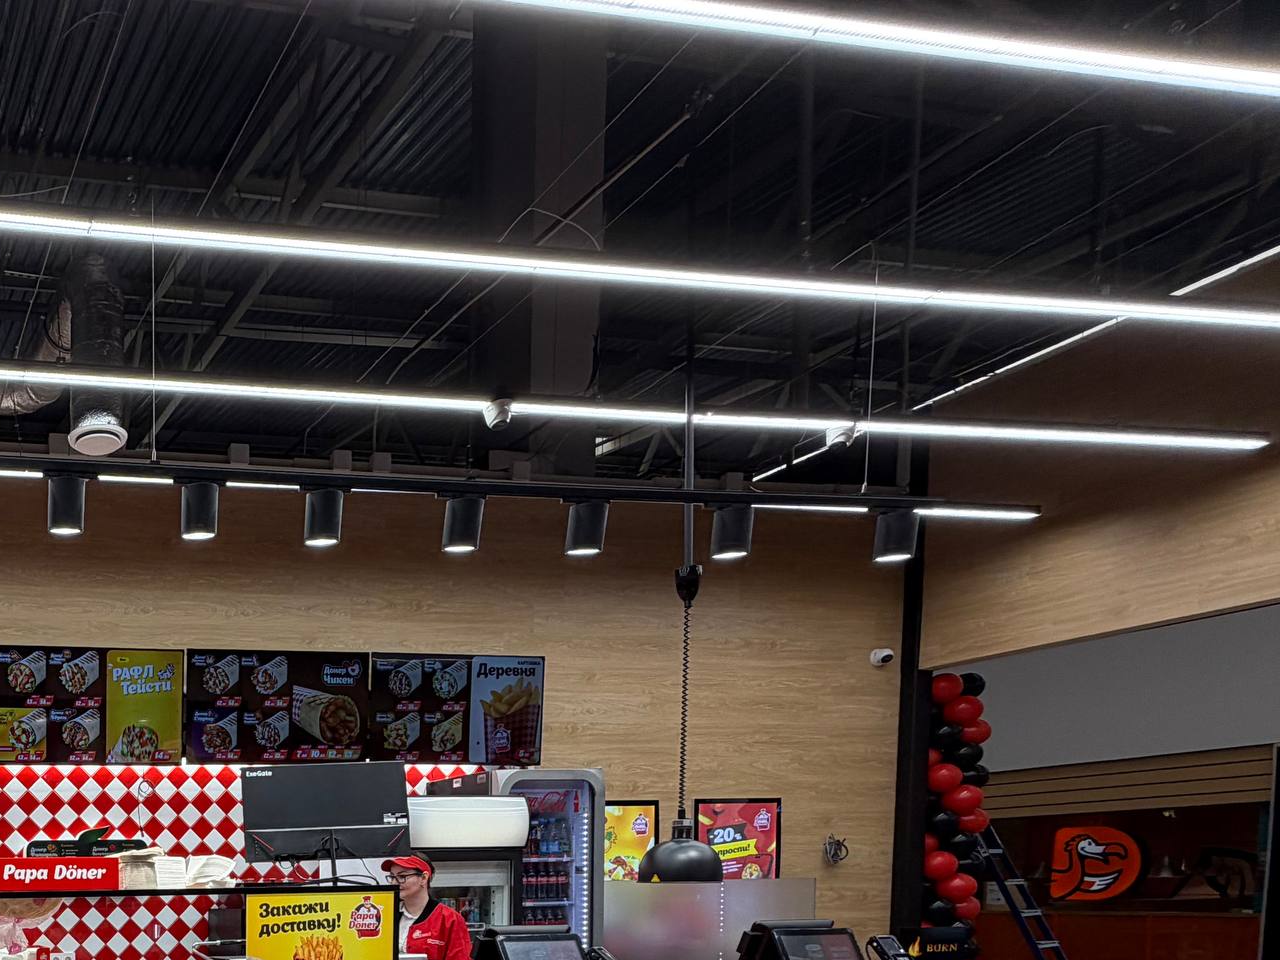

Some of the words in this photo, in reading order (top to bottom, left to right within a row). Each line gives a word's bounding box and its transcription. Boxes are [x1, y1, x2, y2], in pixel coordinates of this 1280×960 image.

[112, 664, 154, 682] РАФЛ
[323, 674, 354, 684] Чикен
[477, 663, 536, 679] Деревня
[121, 679, 173, 695] Тейсти
[3, 864, 48, 883] Papa
[54, 864, 106, 880] Döner
[259, 901, 329, 918] Закажи
[351, 911, 374, 922] Papa
[258, 913, 342, 938] доставку!
[926, 943, 958, 952] BURN
